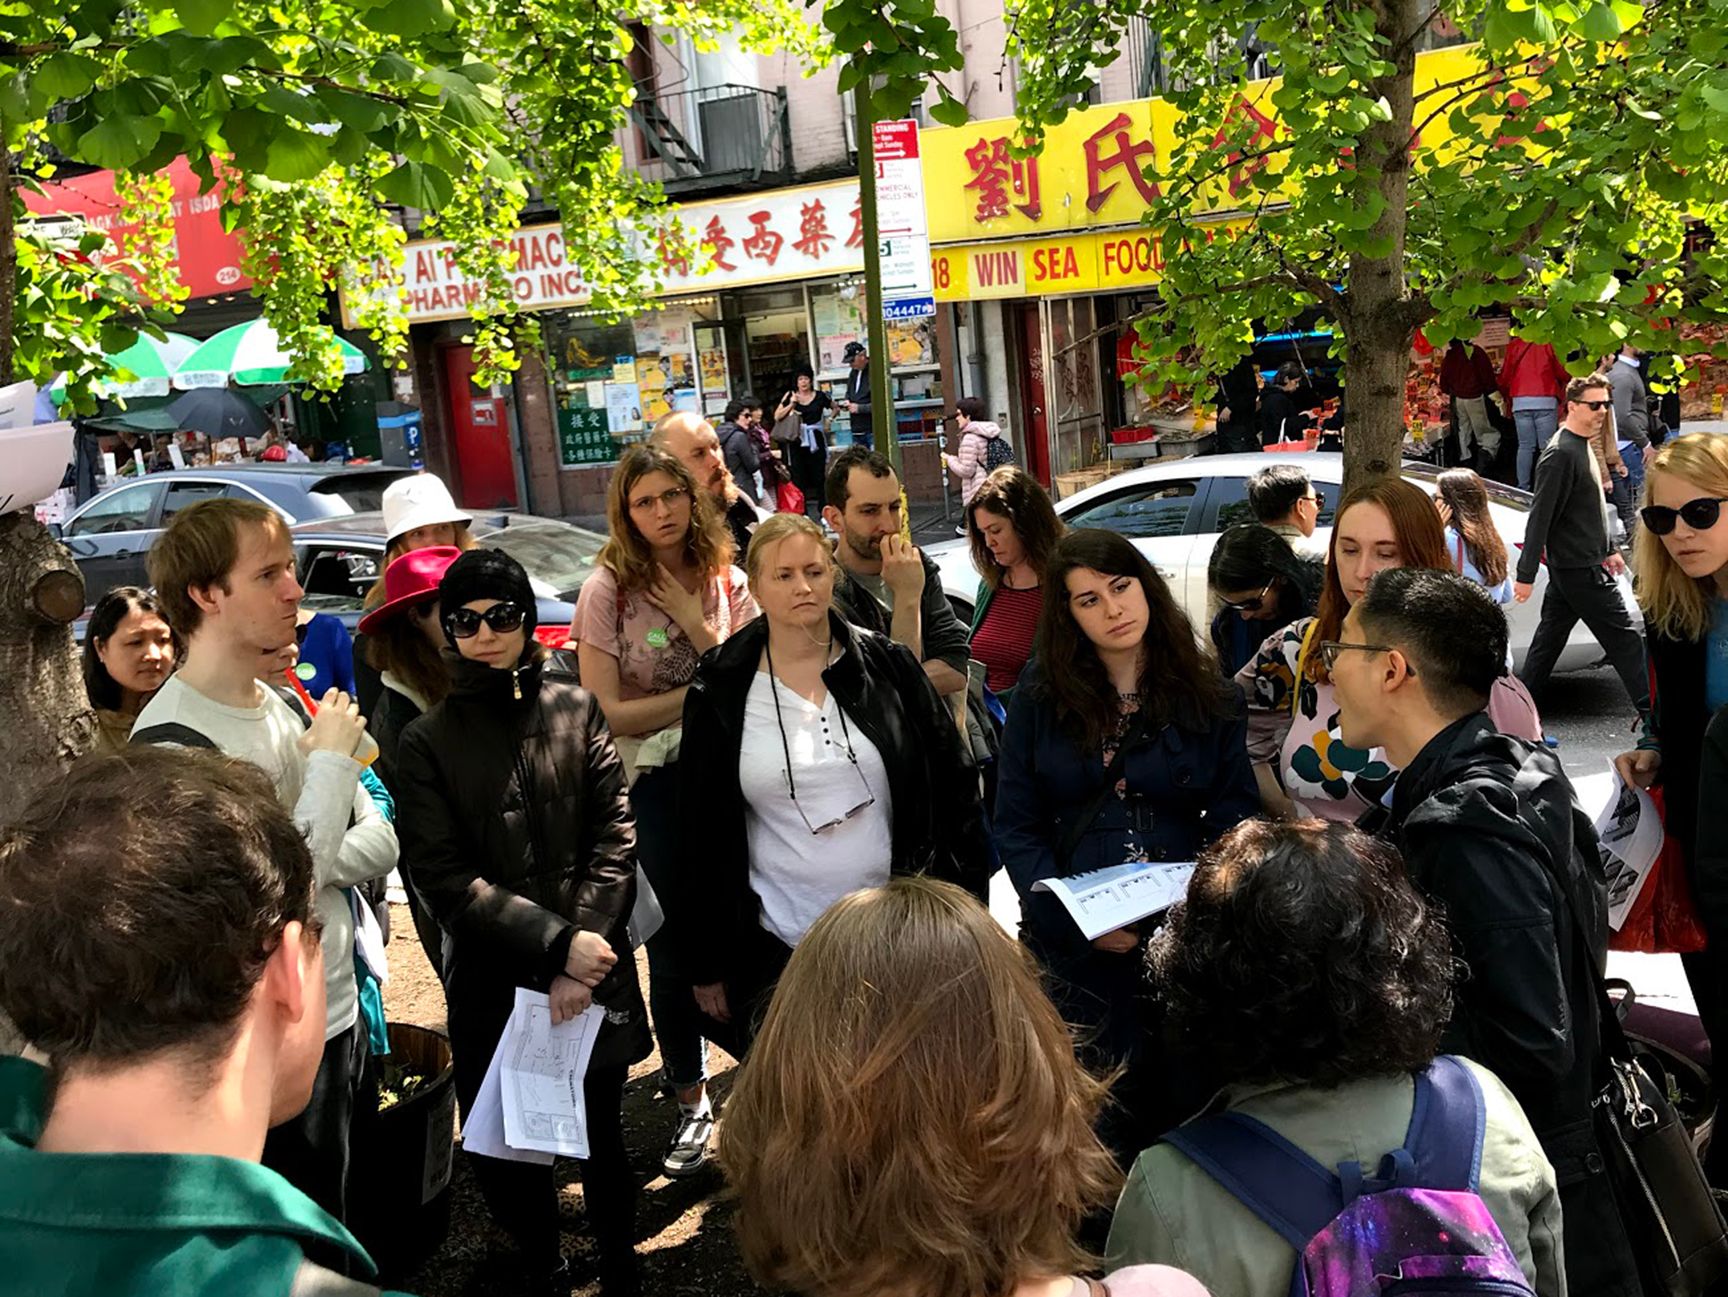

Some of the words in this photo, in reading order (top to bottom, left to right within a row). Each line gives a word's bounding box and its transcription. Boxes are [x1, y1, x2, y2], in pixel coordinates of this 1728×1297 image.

[416, 249, 437, 284] AI
[931, 256, 951, 289] 18
[974, 250, 1019, 287] WIN
[1033, 246, 1080, 282] SEA
[540, 270, 588, 298] INC.
[570, 411, 601, 429] 接受
